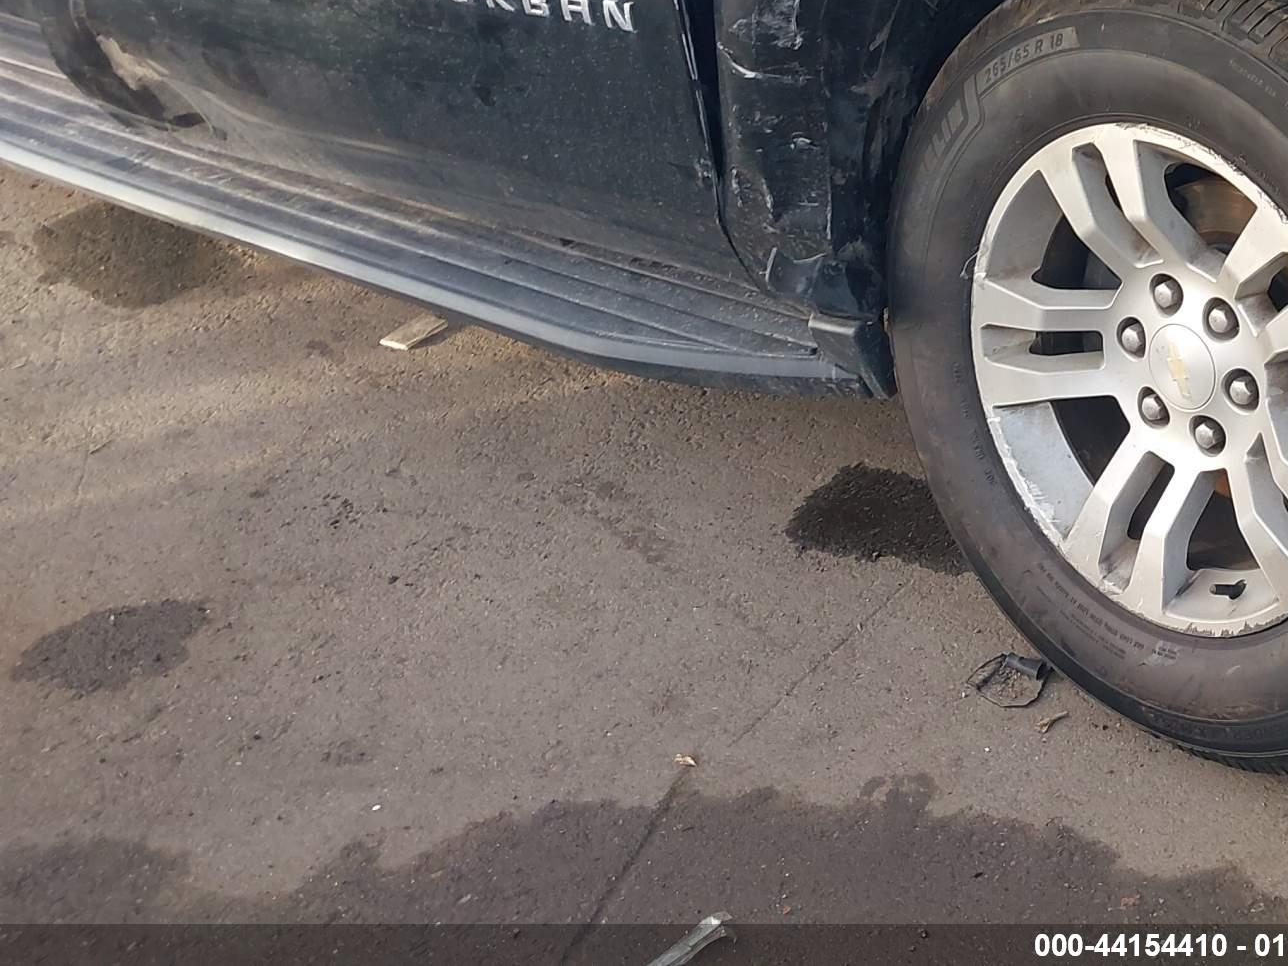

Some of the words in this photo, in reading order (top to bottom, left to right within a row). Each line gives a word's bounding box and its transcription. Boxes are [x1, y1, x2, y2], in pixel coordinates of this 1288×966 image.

[984, 43, 1030, 84] 265/65
[1034, 38, 1044, 54] R
[1050, 33, 1064, 51] 18
